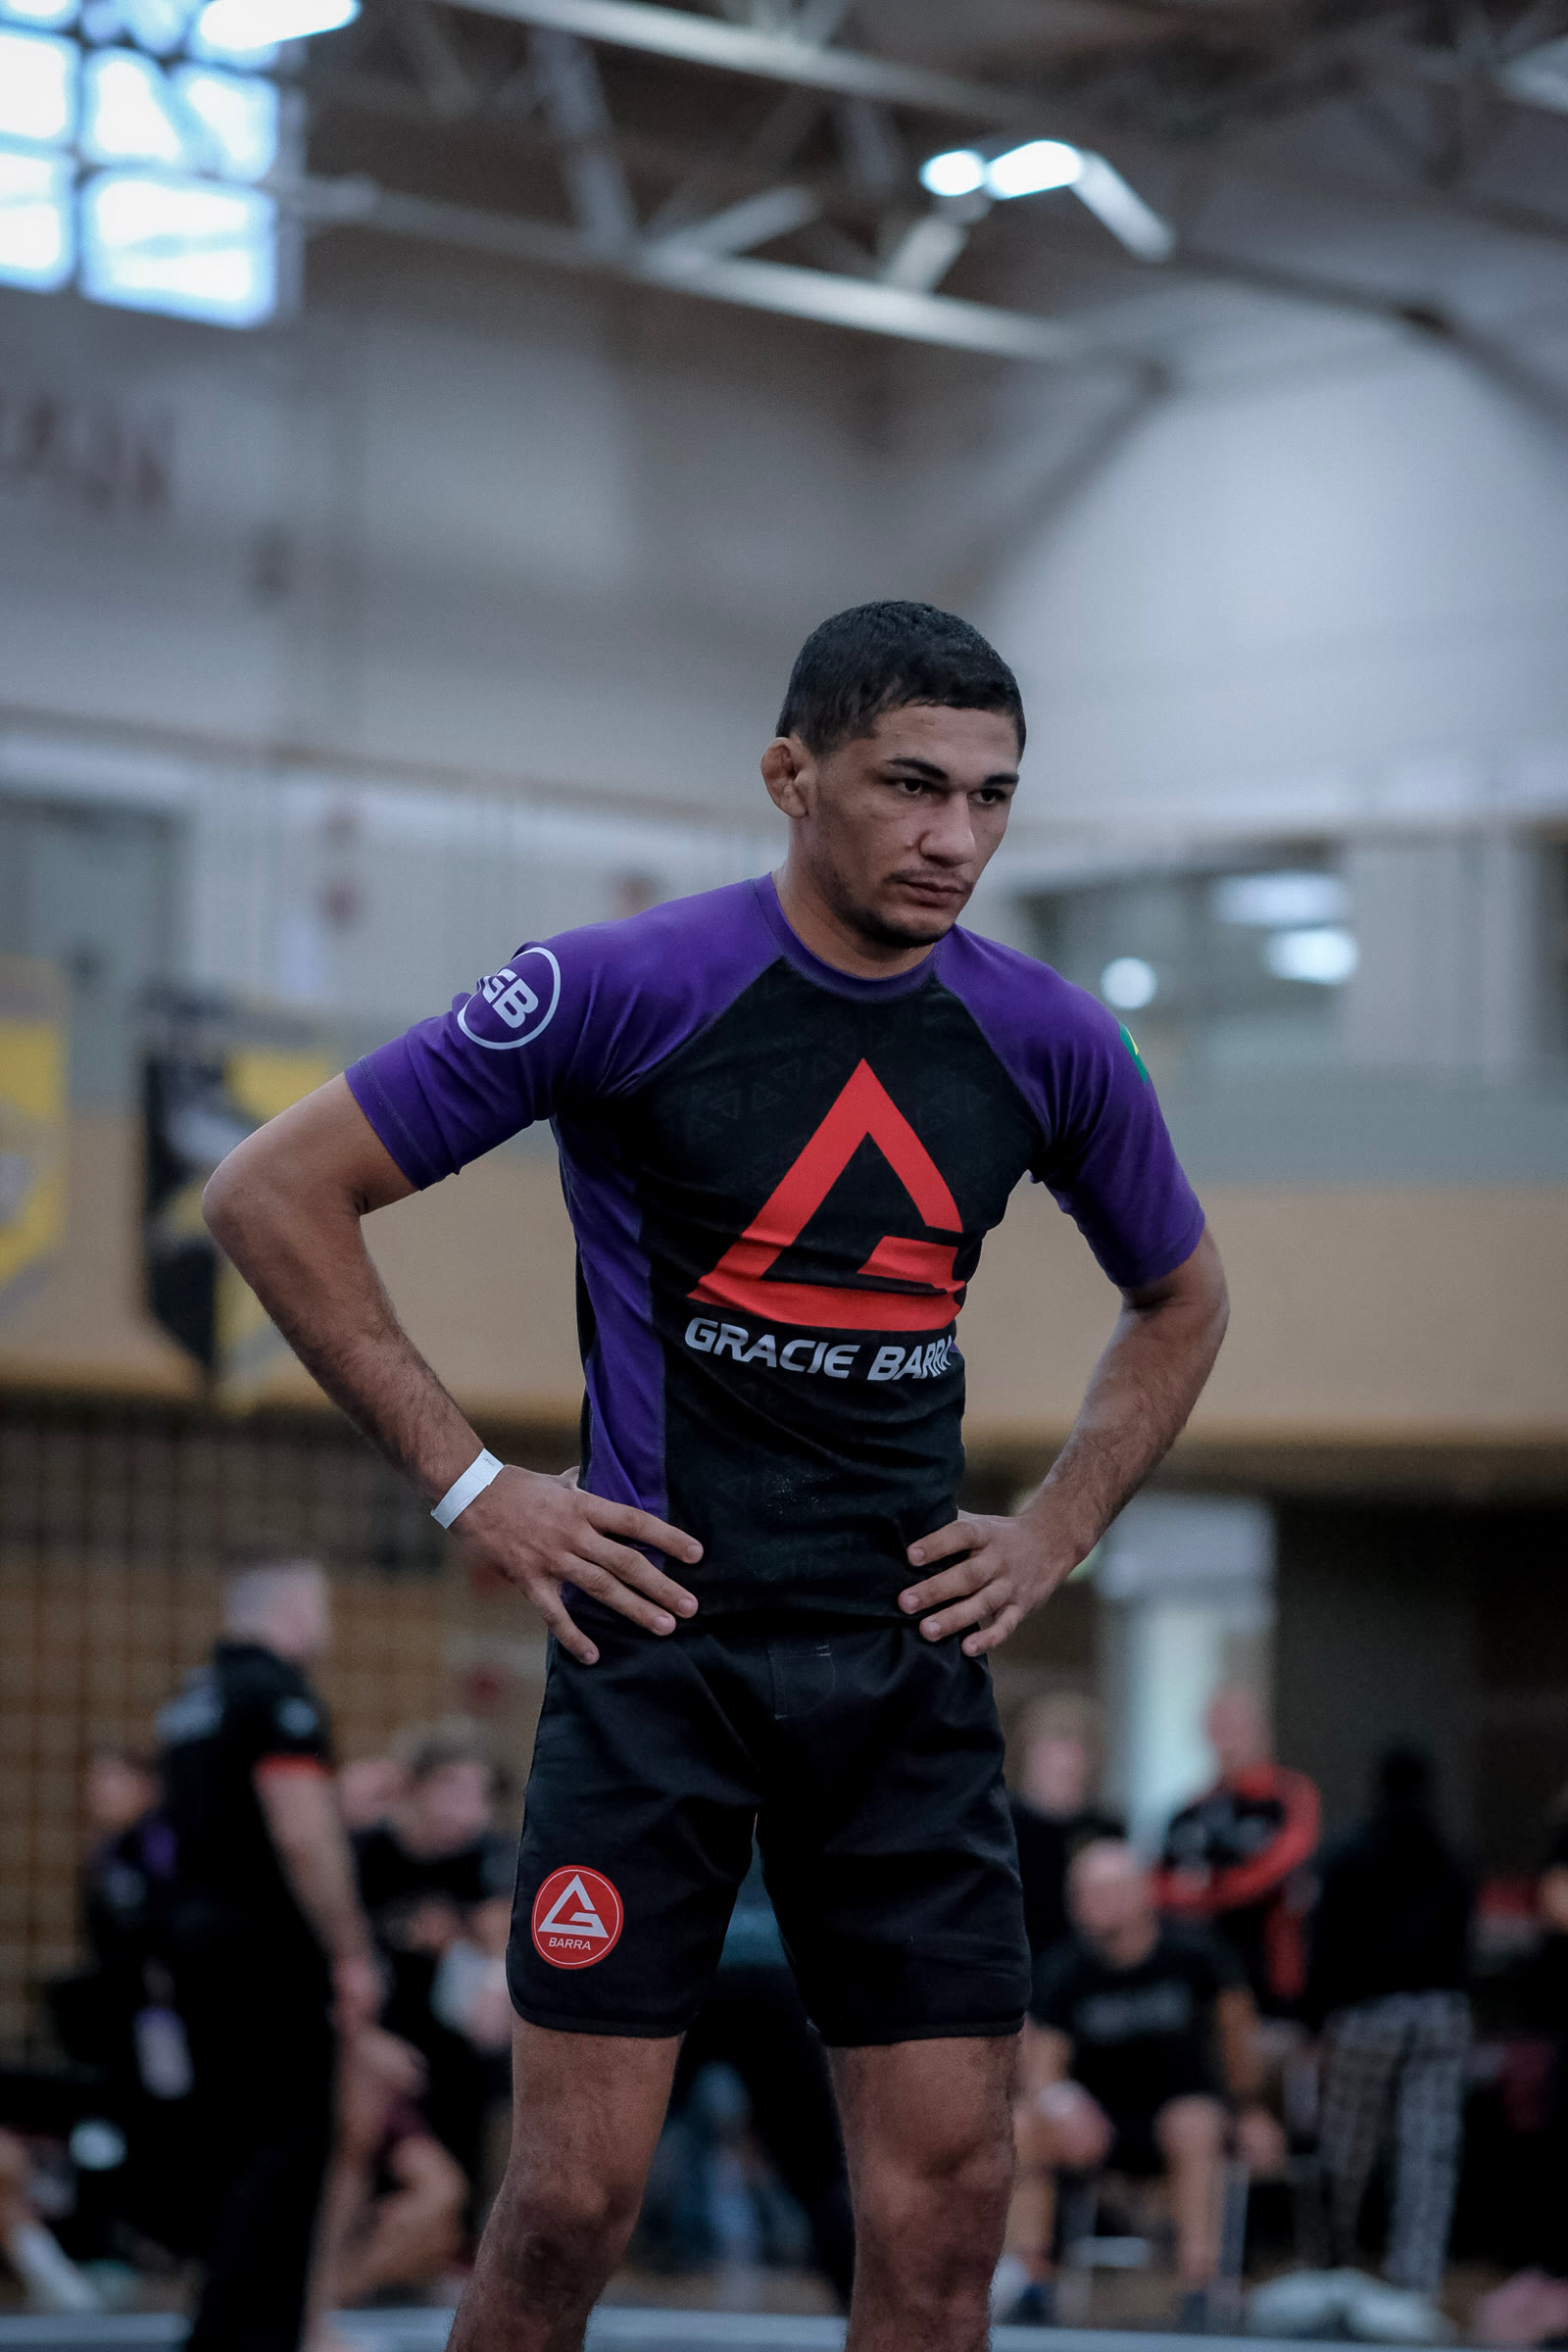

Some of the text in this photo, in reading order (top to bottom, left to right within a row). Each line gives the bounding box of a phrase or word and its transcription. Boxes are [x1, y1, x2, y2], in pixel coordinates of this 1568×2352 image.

[482, 967, 539, 1029] GB
[685, 1317, 953, 1381] GRACIE BARRA
[548, 1936, 592, 1951] BARRA
